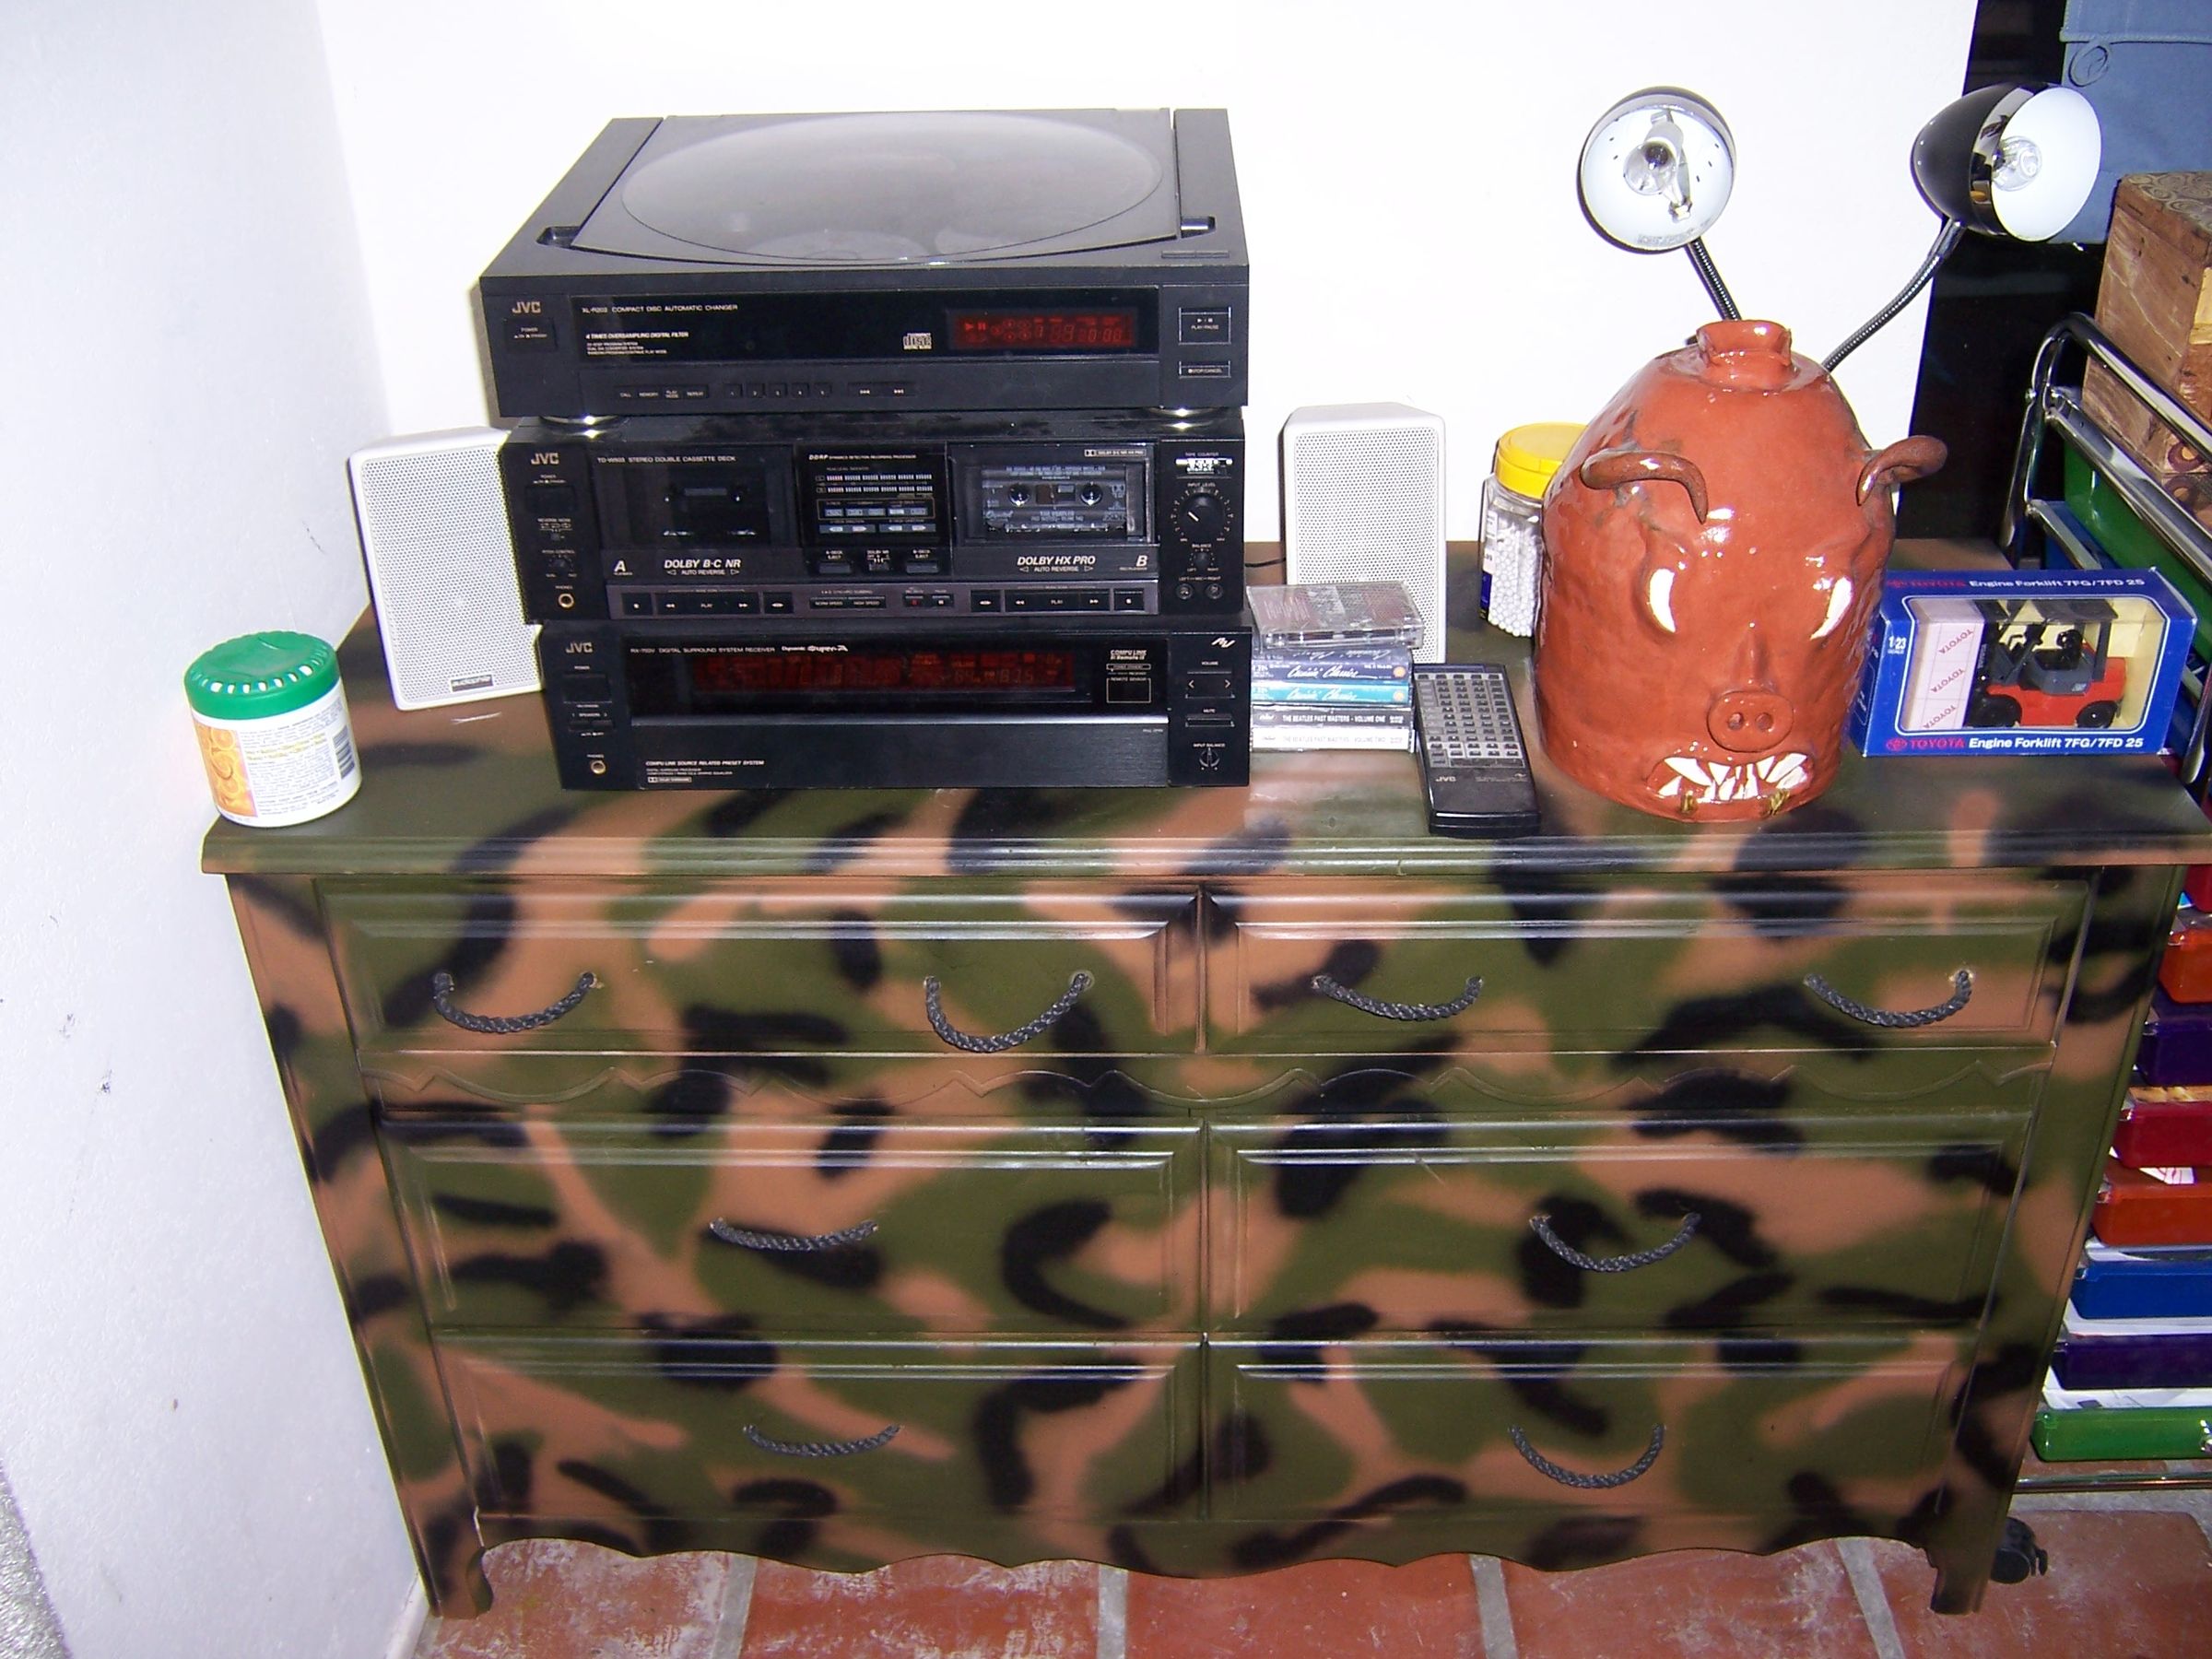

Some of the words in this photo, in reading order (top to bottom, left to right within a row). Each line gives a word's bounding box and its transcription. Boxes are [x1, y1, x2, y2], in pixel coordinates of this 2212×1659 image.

[512, 301, 541, 313] JVC
[531, 453, 559, 465] JVC
[614, 560, 627, 571] A
[665, 559, 700, 569] DOLBY
[725, 559, 741, 568] NR
[1018, 556, 1053, 566] DOLBY
[1055, 556, 1071, 565] HX
[1073, 555, 1096, 565] PRO
[1136, 555, 1148, 567] B
[2064, 579, 2124, 587] 7FG/7FD
[566, 642, 594, 653] JVC
[1938, 629, 1973, 655] TOYOTA
[1931, 668, 1966, 693] TOYOTA
[1923, 705, 1957, 729] TOYOTA
[1911, 737, 1965, 750] TOYOTA
[1969, 737, 2013, 749] Engine
[2015, 737, 2063, 748] Forklift
[2064, 737, 2124, 748] 7FG/7FD
[2124, 737, 2145, 748] 25
